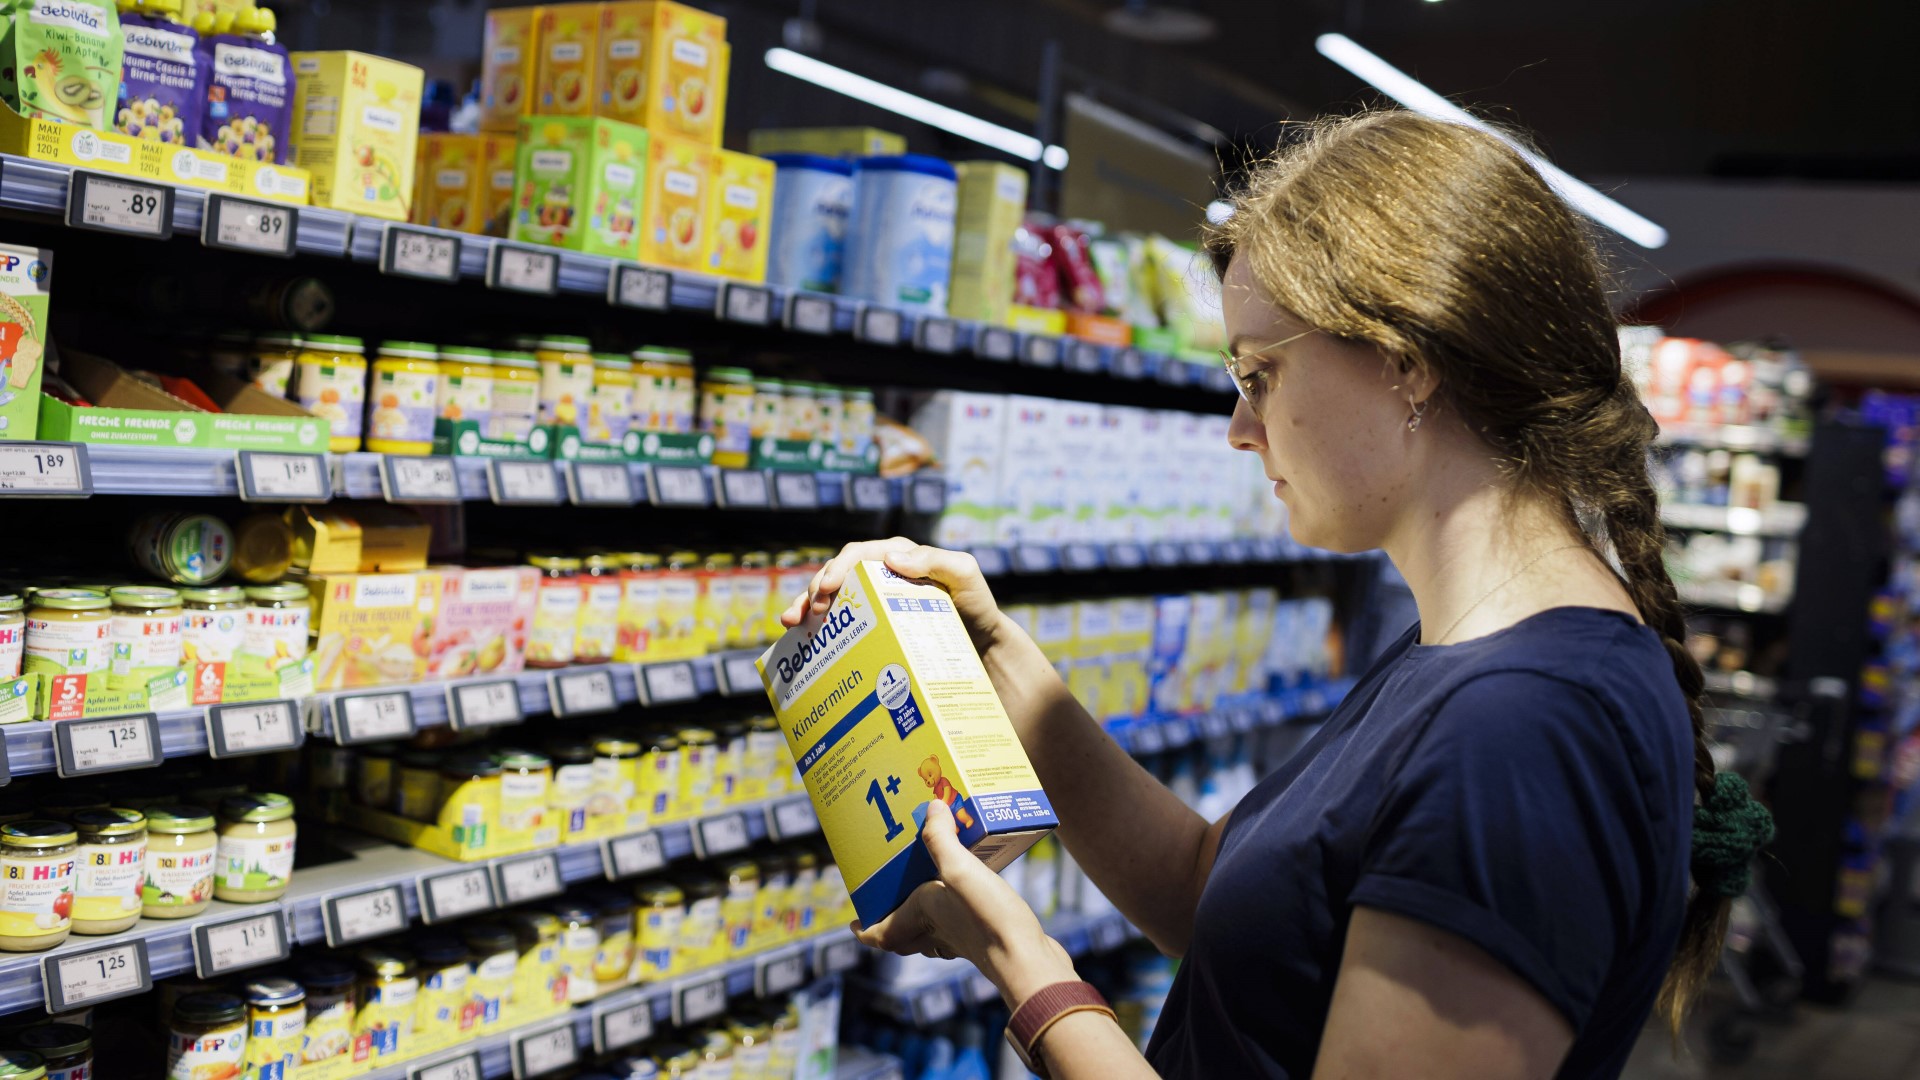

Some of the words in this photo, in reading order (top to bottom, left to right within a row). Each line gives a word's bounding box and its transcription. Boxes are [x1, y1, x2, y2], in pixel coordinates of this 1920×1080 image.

[38, 123, 62, 136] MAXI
[141, 143, 163, 156] MAXI
[78, 415, 121, 427] FRECHE
[124, 417, 171, 429] FREUNDE
[777, 605, 855, 684] Bebivita
[784, 689, 795, 701] MIT
[794, 680, 806, 692] DEN
[804, 649, 836, 684] BAUSTEINEN
[835, 637, 850, 653] FÜRS
[849, 619, 868, 641] LEBEN
[886, 670, 896, 685] 1
[86, 696, 107, 705] Apfel
[791, 669, 864, 741] Kindermilch
[857, 732, 885, 758] Entwicklung
[804, 756, 813, 767] Ab
[811, 752, 816, 760] 1
[815, 742, 827, 757] Jahr
[182, 854, 212, 868] HiPP
[33, 861, 75, 881] HiPP
[8, 882, 36, 890] FRUCHT
[97, 955, 126, 979] 1,25
